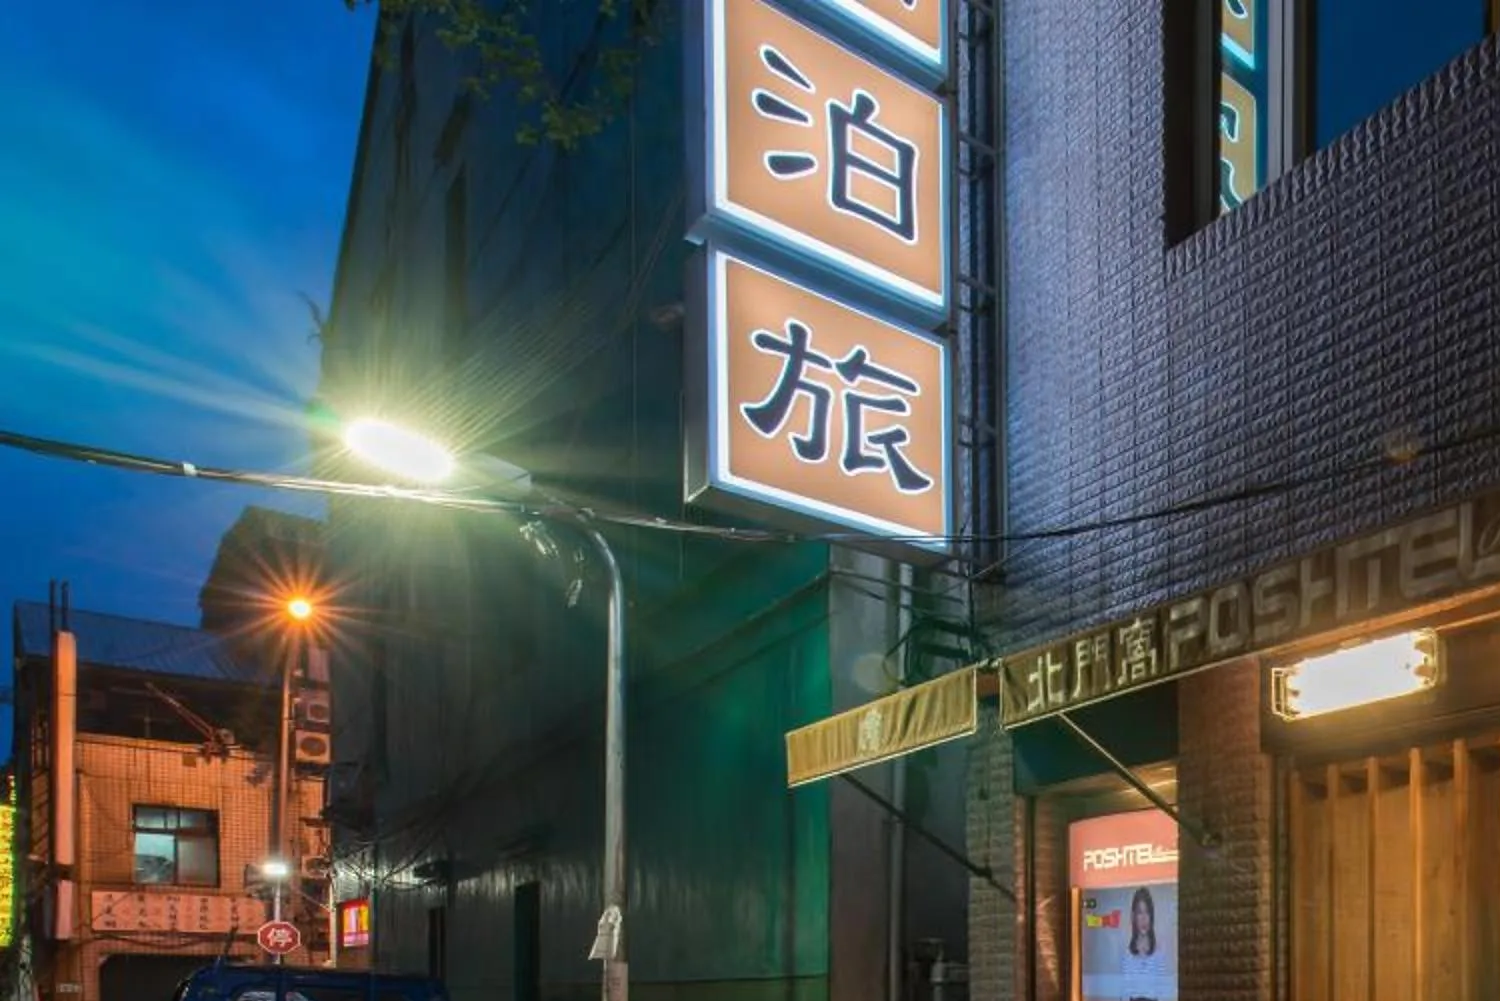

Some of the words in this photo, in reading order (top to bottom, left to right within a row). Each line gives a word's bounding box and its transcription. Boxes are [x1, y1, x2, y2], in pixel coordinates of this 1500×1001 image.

[741, 0, 933, 494] 泊旅
[1167, 502, 1480, 672] POSHTEL
[1027, 617, 1157, 712] 北門窩
[266, 928, 293, 947] 停
